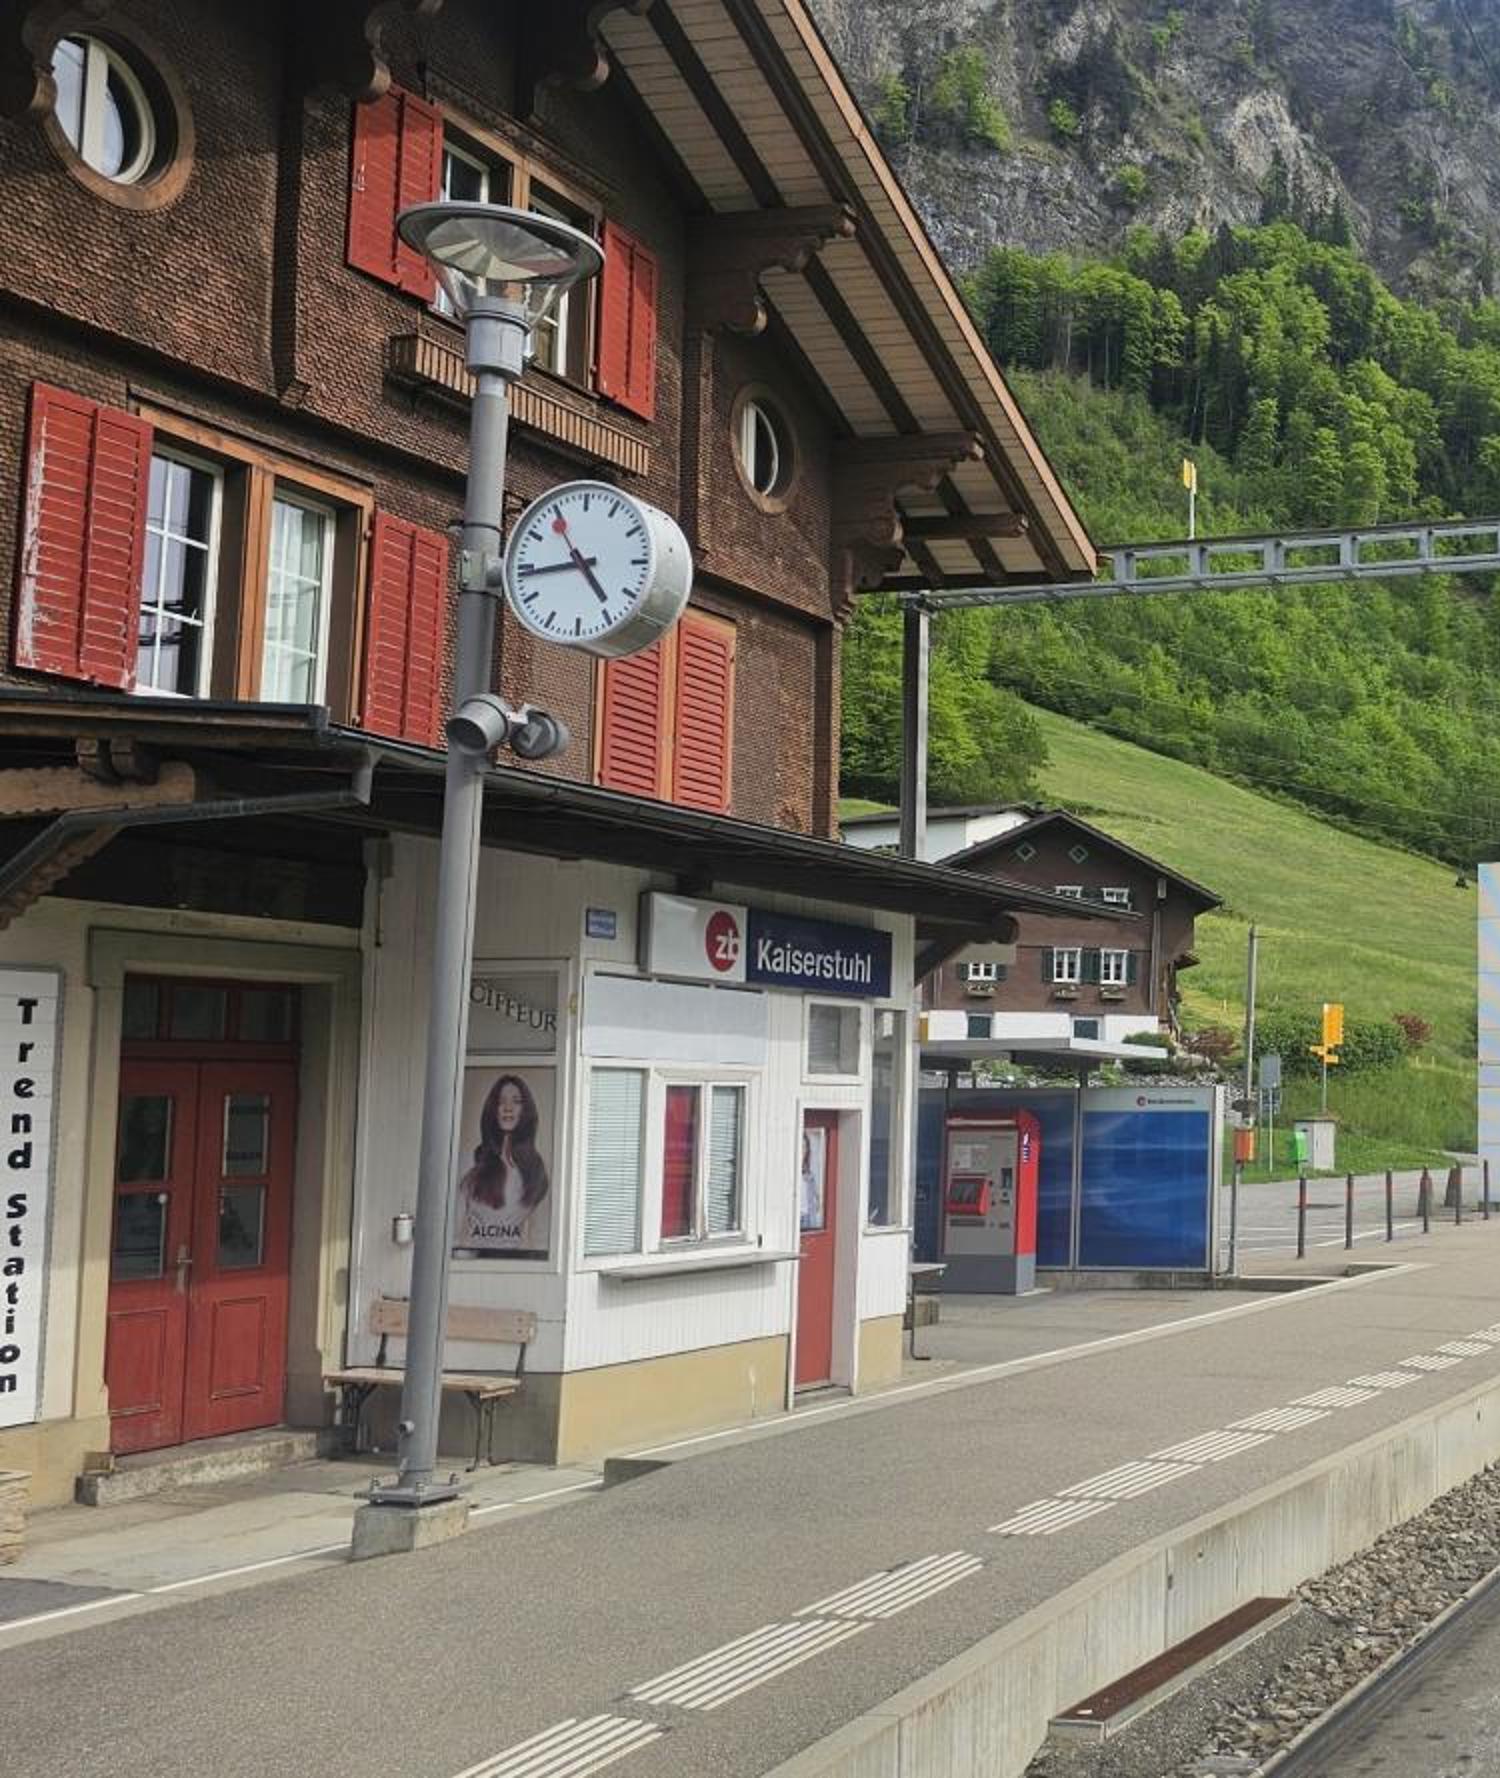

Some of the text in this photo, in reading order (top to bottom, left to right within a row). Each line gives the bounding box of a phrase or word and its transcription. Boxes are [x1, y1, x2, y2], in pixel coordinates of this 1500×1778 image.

[715, 929, 740, 961] zb
[757, 938, 871, 983] Kaiserstuhl
[470, 982, 557, 1032] OIFFEUR
[0, 998, 38, 1393] Trend Station
[471, 1225, 521, 1237] ALCINA
